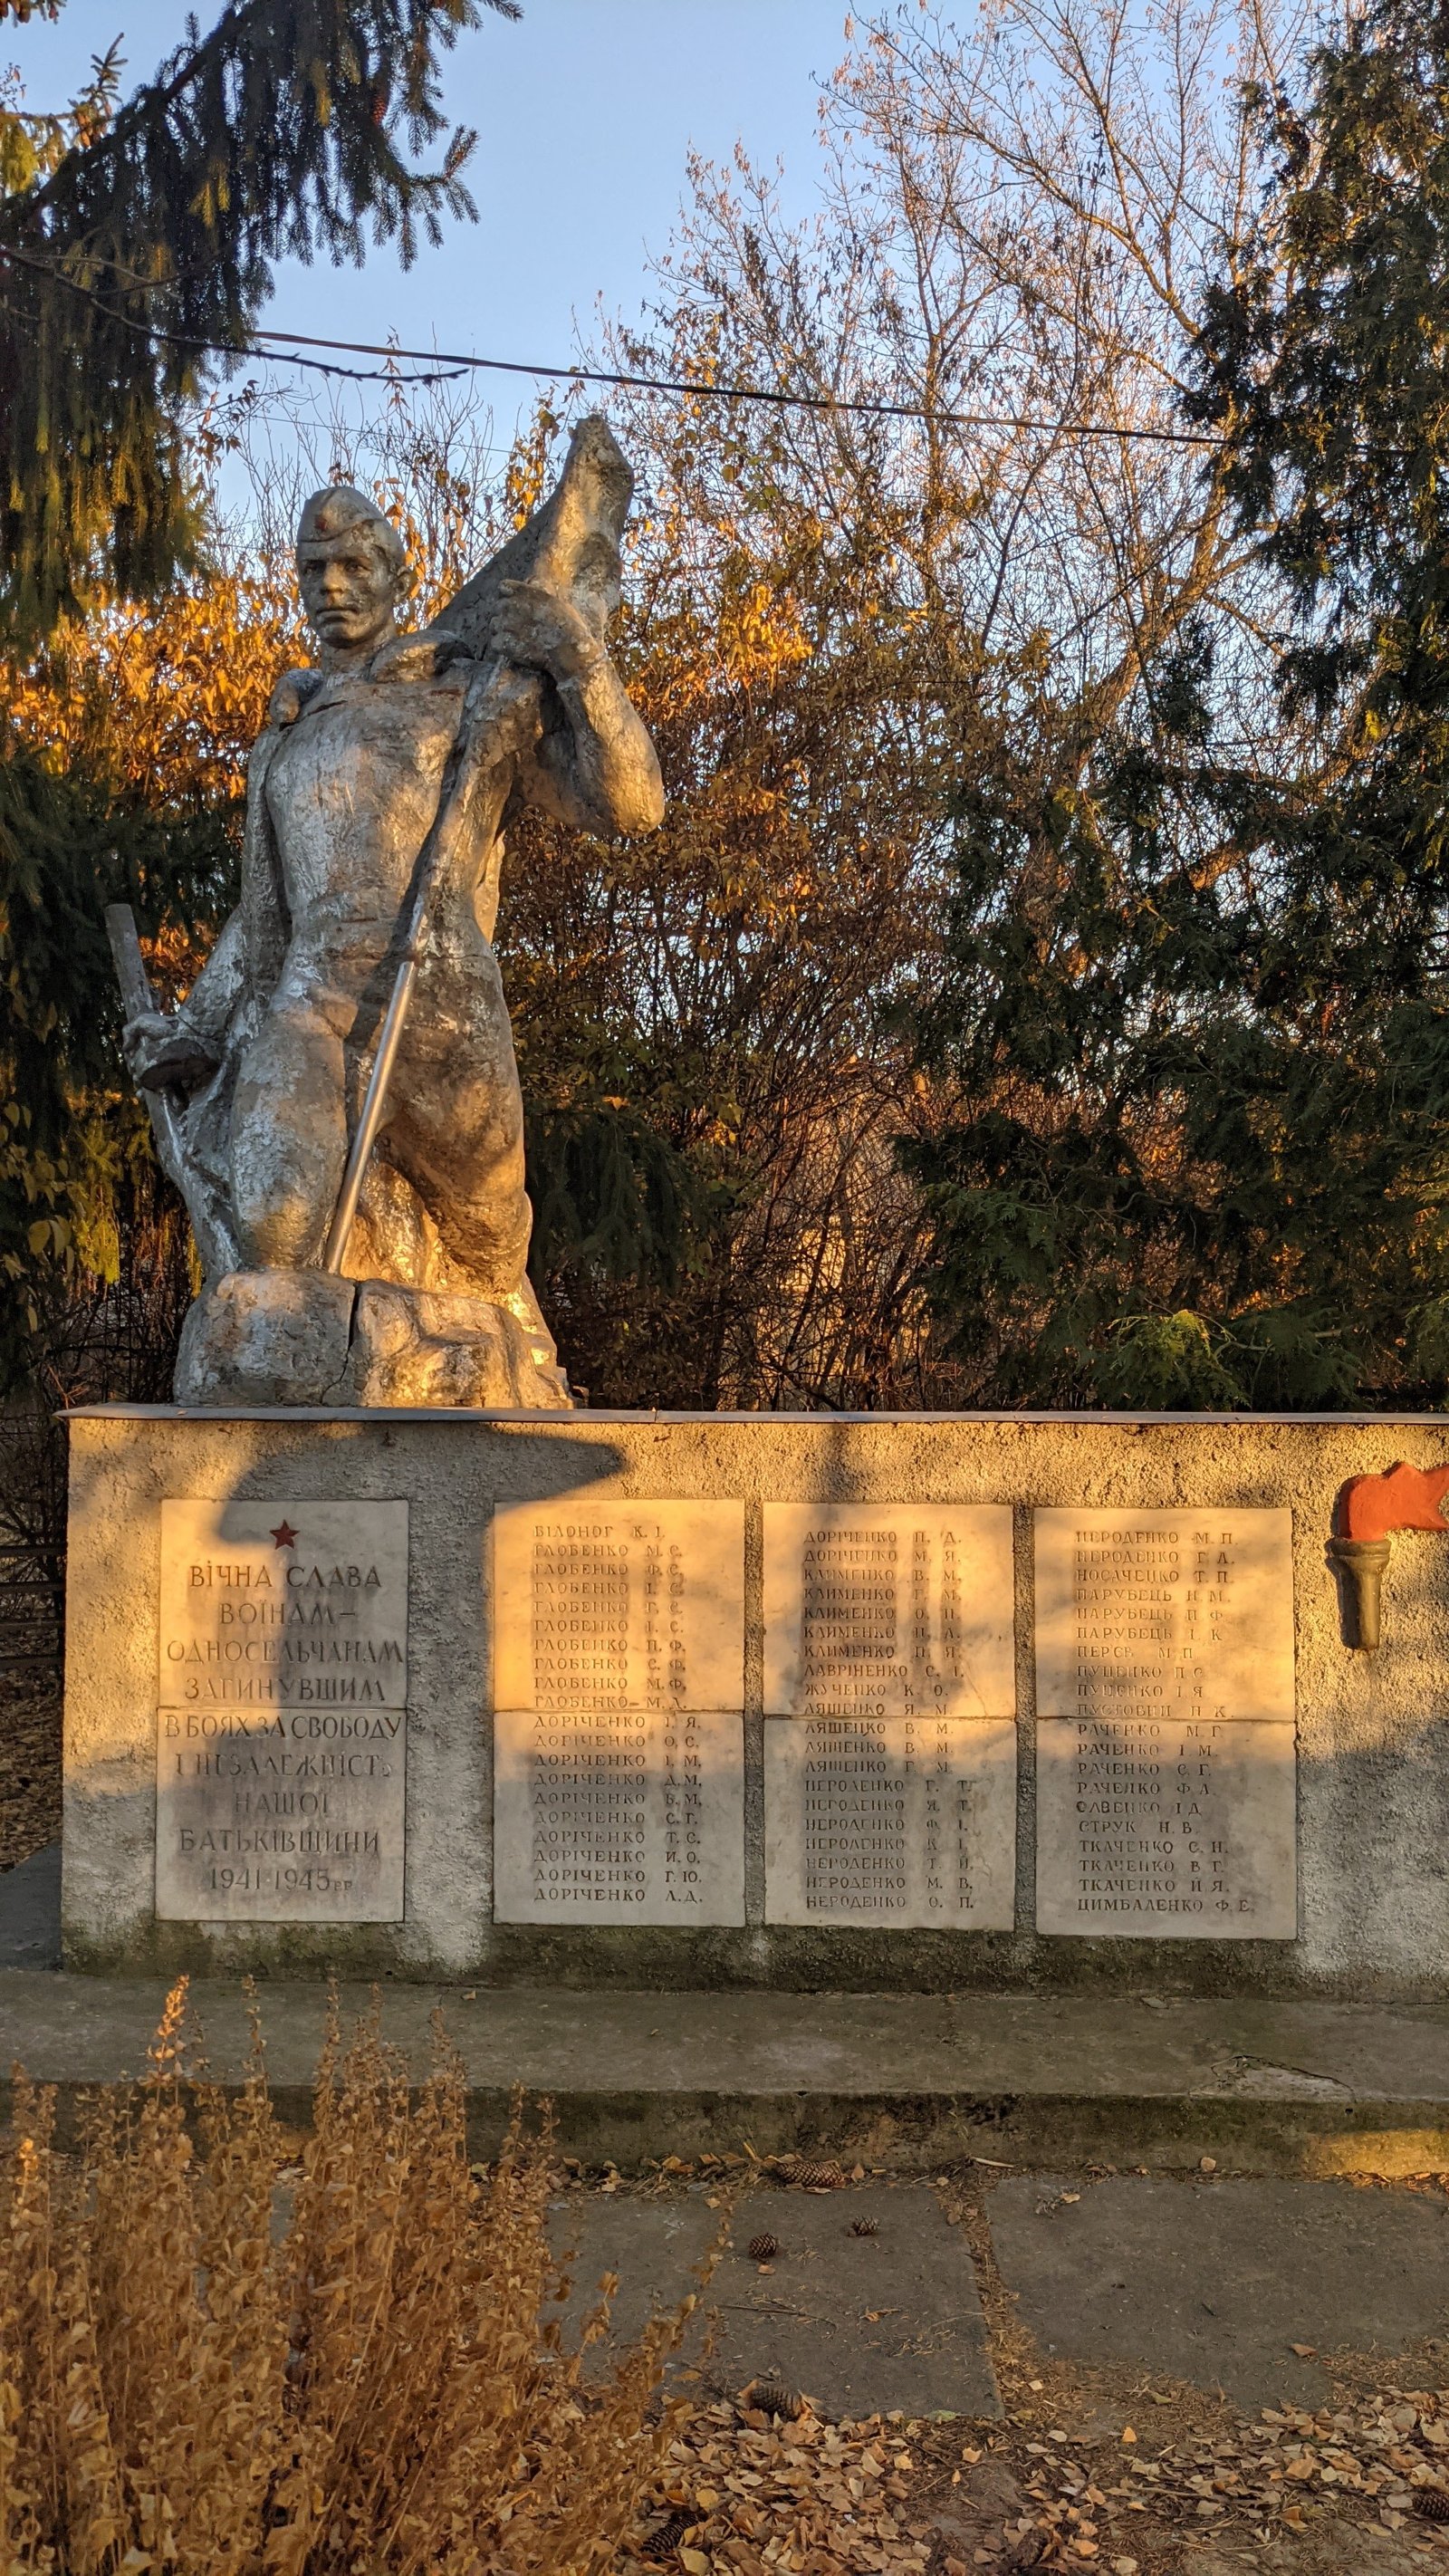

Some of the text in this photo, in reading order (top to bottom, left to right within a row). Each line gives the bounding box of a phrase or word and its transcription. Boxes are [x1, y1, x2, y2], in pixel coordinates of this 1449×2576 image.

[534, 1526, 613, 1538] БІЛОНОГ
[632, 1526, 648, 1538] К.
[804, 1532, 897, 1543] ДОРІЧЕНКО
[915, 1532, 930, 1543] П.
[1076, 1532, 1178, 1544] НЕРОДЕНКО
[534, 1544, 629, 1557] ГЛОБЕНКО
[646, 1544, 663, 1557] М.
[804, 1550, 961, 1562] ДОРІЧЕНКО Я.
[1077, 1551, 1178, 1564] НЕРОДЕНКО
[534, 1563, 629, 1575] ГЛОБЕНКО
[286, 1565, 380, 1587] СЛАВА
[804, 1570, 962, 1581] КЛИМЕНКО В. М.
[534, 1582, 628, 1594] ГЛОБЕНКО
[804, 1589, 894, 1600] КЛИМЕНКО
[1077, 1589, 1171, 1601] ПАРУБЕЦЬ
[534, 1601, 628, 1613] ГЛОБЕНКО
[804, 1607, 929, 1620] КЛИМЕНКО О.
[1077, 1608, 1172, 1620] ПАРУБЕЦЬ
[534, 1620, 683, 1632] ГЛОБЕНКО І. С.
[804, 1627, 895, 1638] КЛИМЕНКО
[1077, 1627, 1172, 1640] ПАРУБЕЦЬ
[534, 1639, 686, 1651] ГЛОБЕНКО П. Ф.
[167, 1640, 403, 1664] ОДНОСЕЛЬЧАНАМ
[804, 1646, 895, 1658] КЛИМЕНКО
[534, 1658, 628, 1670] ГЛОБЕНКО
[669, 1659, 686, 1670] Ф.
[804, 1665, 964, 1677] ЛАВРІНЕНКО С. І.
[1078, 1666, 1162, 1677] ПУЦЕНКО
[185, 1677, 385, 1701] ЗАГИНУВШИМ
[534, 1677, 686, 1690] ГЛОБЕНКО М. Ф.
[805, 1684, 886, 1696] ЖУЧЕНКО
[934, 1685, 948, 1696] О.
[1078, 1685, 1163, 1697] ПУЦЕНКО
[647, 1697, 665, 1708] М.
[804, 1703, 920, 1715] ЛЯШЕНКО Я.
[166, 1716, 401, 1739] В БОЯХ ЗА СВОБОДУ
[533, 1716, 645, 1729] ДОРІЧЕНКО
[686, 1716, 701, 1729] Я.
[805, 1723, 886, 1735] ЛЯШЕНКО
[936, 1723, 954, 1734] М.
[1078, 1724, 1159, 1736] РАЧЕНКО
[534, 1735, 645, 1747] ДОРІЧЕНКО
[685, 1736, 699, 1748] С.
[805, 1742, 886, 1754] ЛЯШЕНКО
[936, 1742, 954, 1754] М.
[1078, 1744, 1159, 1755] РАЧЕНКО
[176, 1754, 183, 1775] І
[534, 1754, 645, 1766] ДОРІЧЕНКО
[685, 1755, 701, 1767] М.
[806, 1761, 886, 1773] ЛЯШЕНКО
[1078, 1763, 1159, 1775] РАЧЕНКО
[1199, 1764, 1211, 1776] Г.
[534, 1773, 702, 1787] ДОРІЧЕНКО Д. М.
[805, 1780, 939, 1792] НЕРОДЕНКО Г.
[534, 1793, 645, 1805] ДОРІЧЕНКО
[685, 1793, 702, 1806] М.
[805, 1800, 904, 1812] НЕРОДЕНКО
[1077, 1802, 1159, 1813] САВЕНКО
[534, 1812, 697, 1824] ДОРІЧЕНКО С. Г.
[806, 1819, 904, 1831] НЕРОДЕНКО
[1079, 1821, 1175, 1834] СТРУК Н.
[180, 1830, 379, 1854] БАТЬКІВЩИНИ
[534, 1831, 701, 1844] ДОРІЧЕНКО Т. С.
[806, 1838, 904, 1850] НЕРОДЕНКО
[1080, 1841, 1174, 1854] ТКАЧЕНКО
[1212, 1841, 1228, 1853] Н.
[534, 1850, 700, 1864] ДОРІЧЕНКО И. О.
[807, 1858, 904, 1870] НЕРОДЕНКО
[1080, 1860, 1174, 1872] ТКАЧЕНКО
[534, 1870, 702, 1883] ДОРІЧЕНКО Г. Ю.
[807, 1877, 973, 1889] НЕРОДЕНКО М. В.
[1080, 1879, 1230, 1892] ТКАЧЕНКО Я.
[534, 1889, 645, 1901] ДОРІЧЕНКО
[686, 1890, 703, 1904] Д.
[807, 1896, 974, 1909] НЕРОДЕНКО О. П.
[1078, 1898, 1203, 1913] ЦИМБАЛЕНКО
